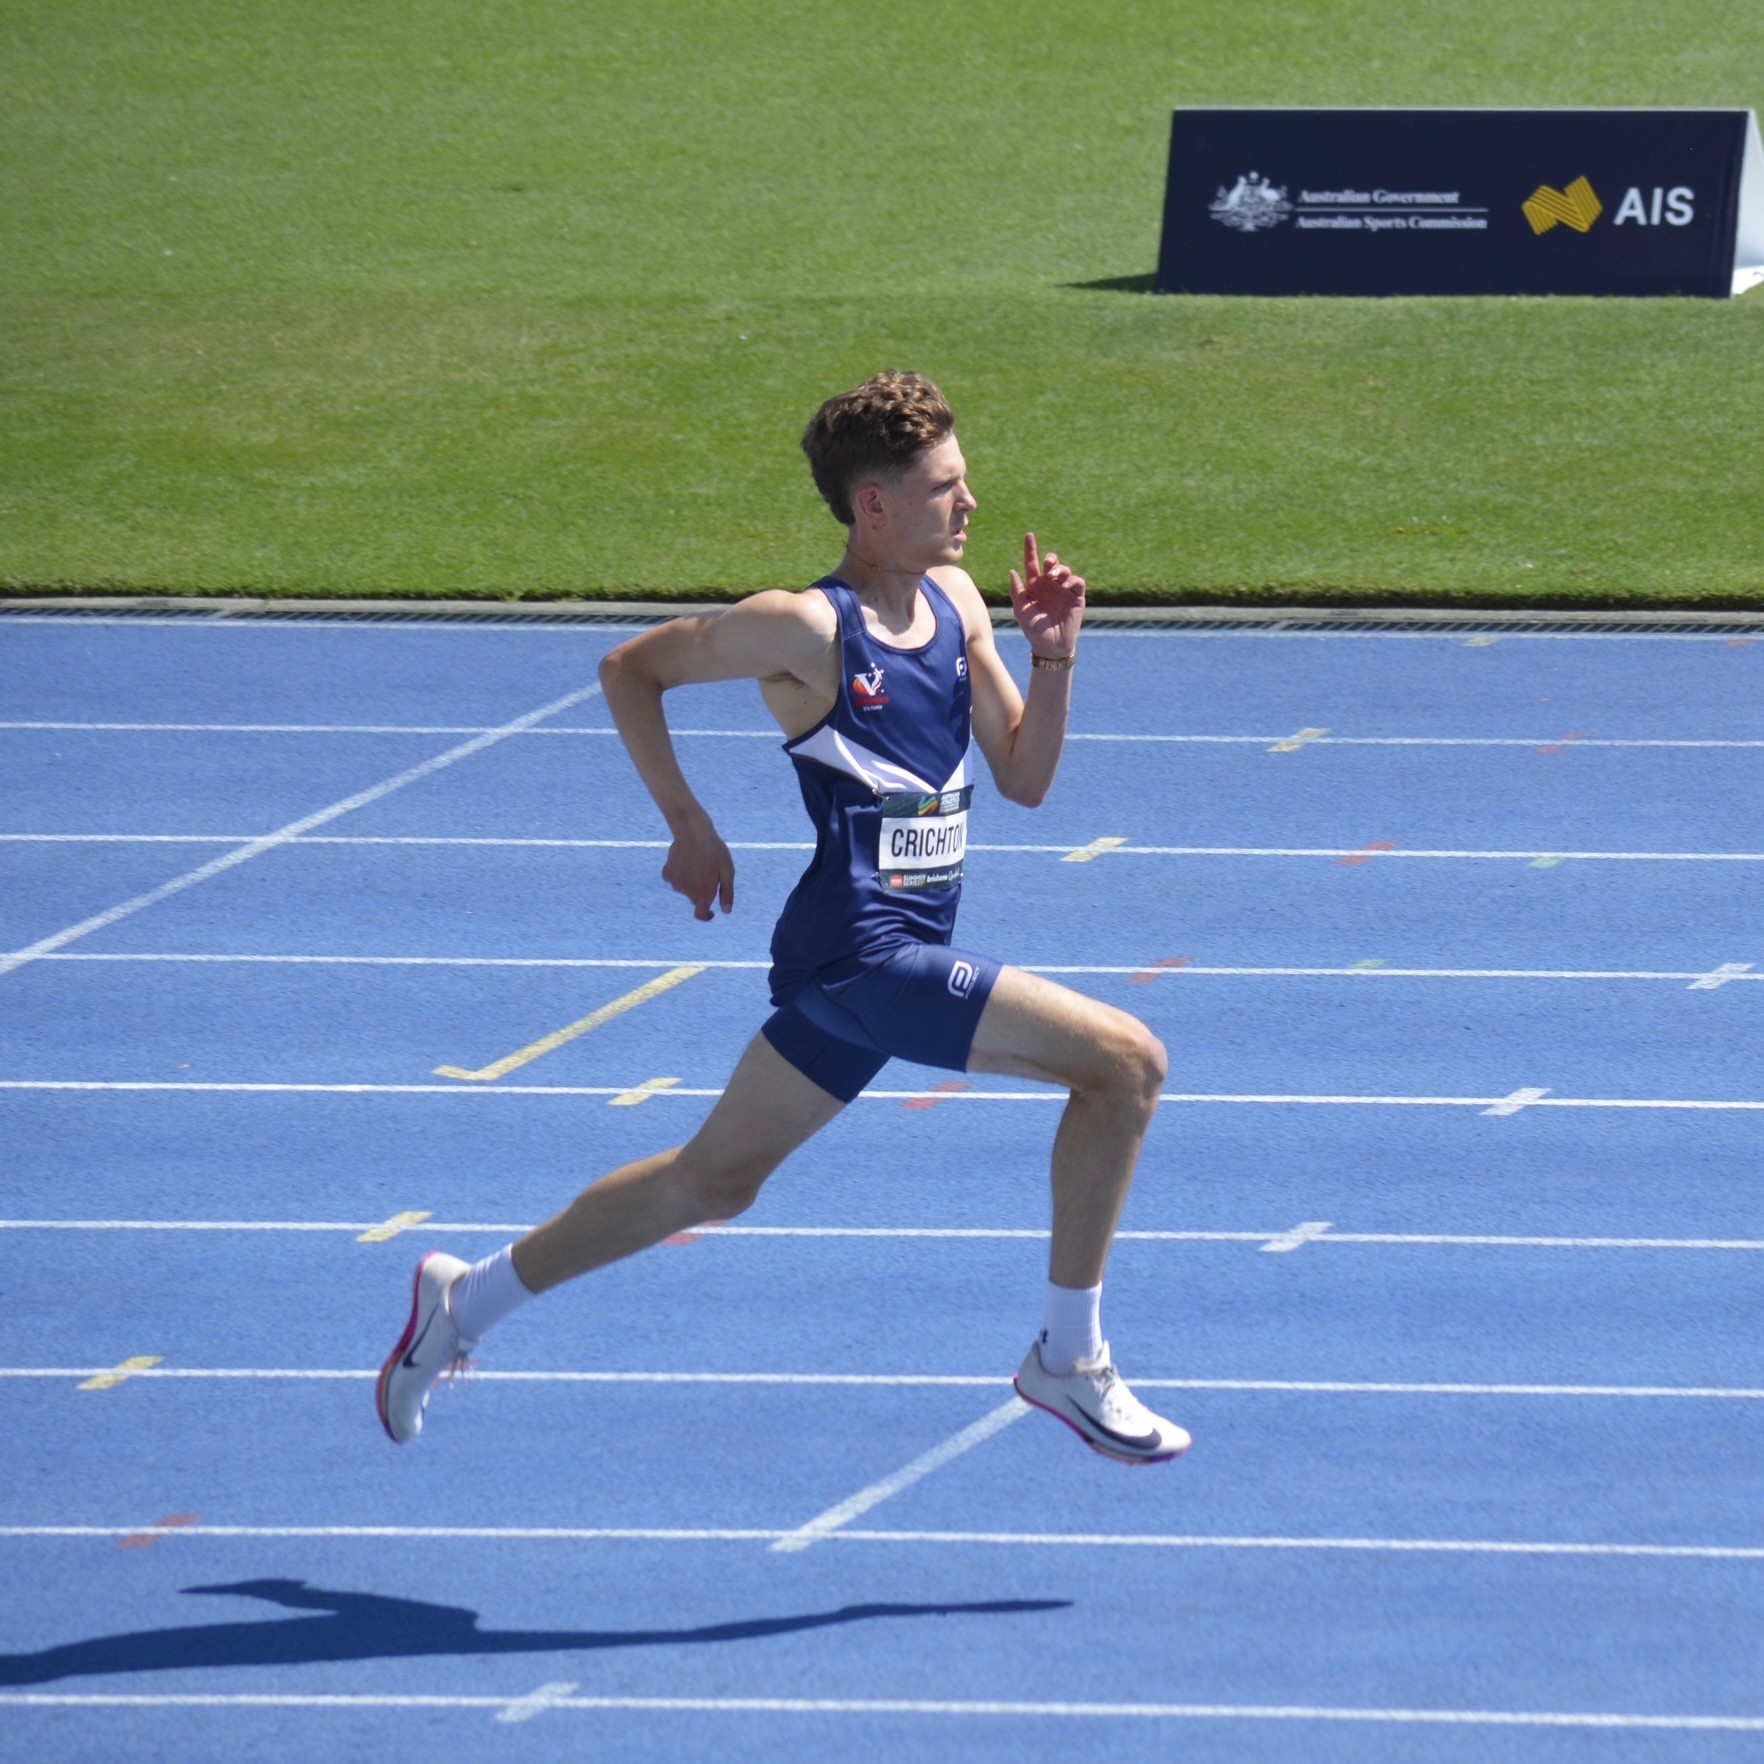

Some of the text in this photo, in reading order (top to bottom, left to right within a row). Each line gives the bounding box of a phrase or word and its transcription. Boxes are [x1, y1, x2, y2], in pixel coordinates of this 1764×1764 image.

[1299, 189, 1459, 203] Australian Government
[1613, 186, 1695, 226] AIS
[1296, 215, 1487, 232] Australian Sports Commission
